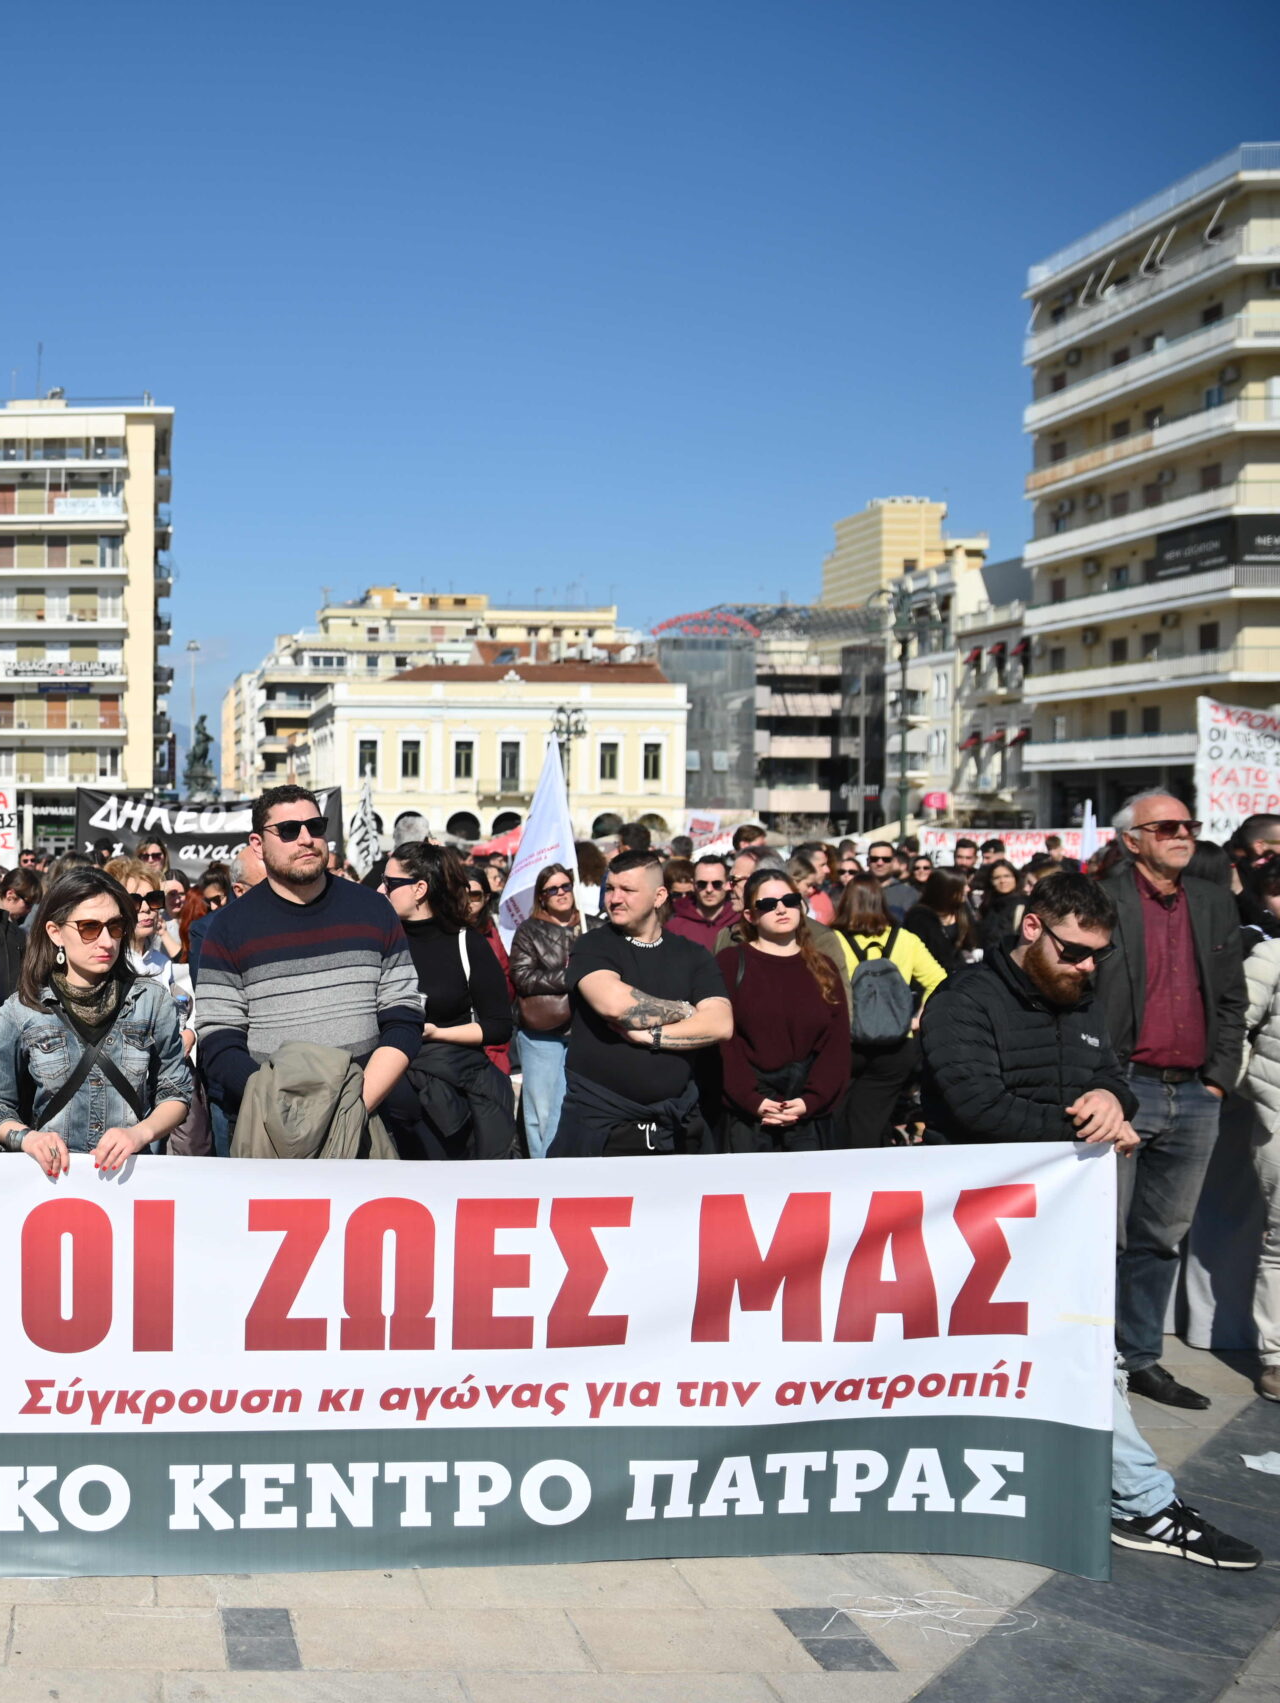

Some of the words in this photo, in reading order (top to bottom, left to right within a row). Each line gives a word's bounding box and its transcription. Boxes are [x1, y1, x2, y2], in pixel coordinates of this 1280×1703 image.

[20, 1197, 176, 1354] ΟΙ
[243, 1196, 635, 1352] ΖΩΕΣ
[690, 1183, 1038, 1343] ΜΑΣ
[18, 1376, 303, 1426] Σύγκρουση
[318, 1387, 364, 1414] κι
[379, 1373, 570, 1421] αγώνας
[586, 1380, 659, 1419] για
[676, 1380, 761, 1408] την
[774, 1358, 1034, 1409] ανατροπή!
[168, 1458, 592, 1531] ΚΕΝΤΡΟ
[625, 1447, 1027, 1522] ΠΑΤΡΑΣ
